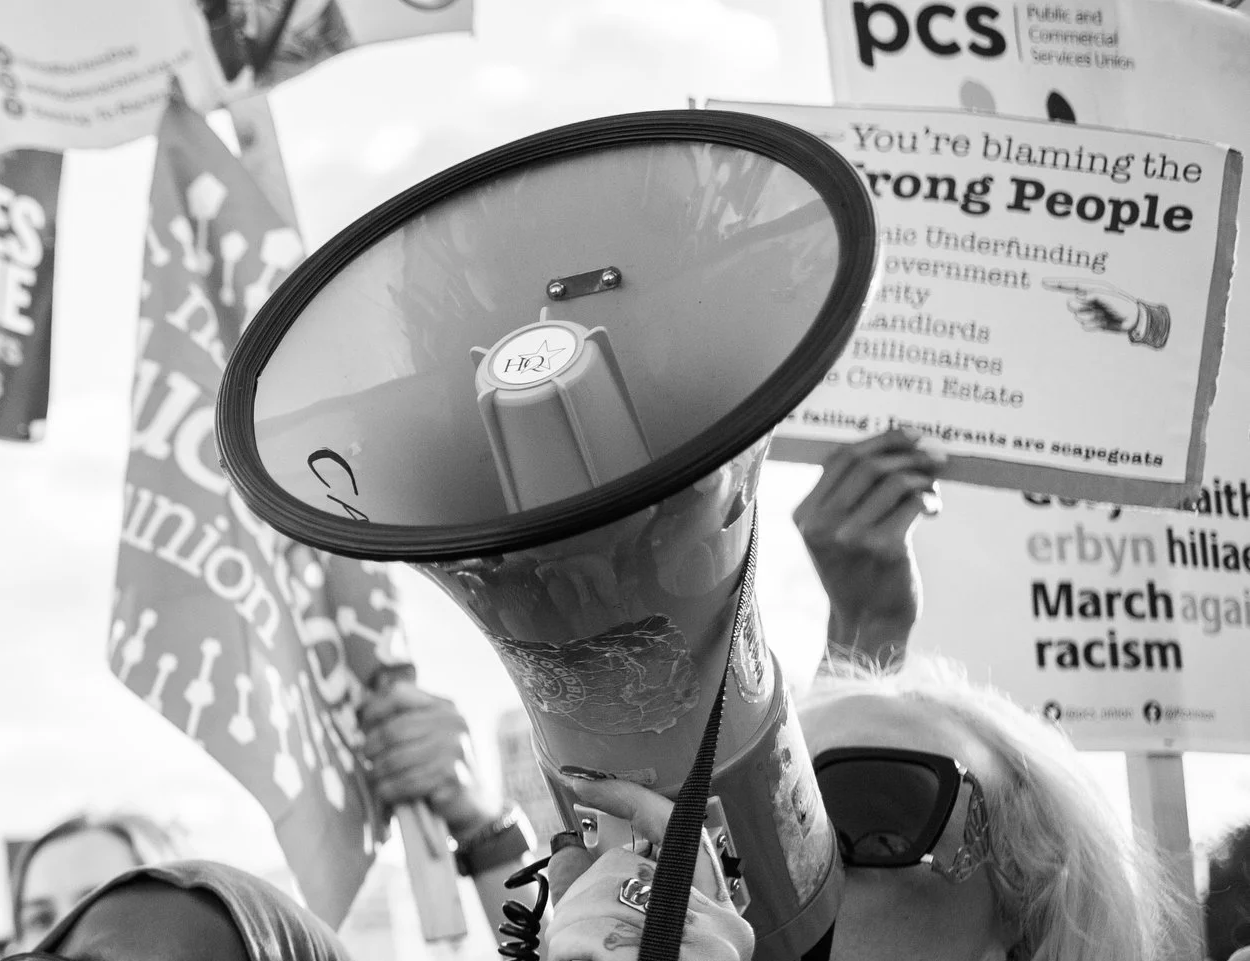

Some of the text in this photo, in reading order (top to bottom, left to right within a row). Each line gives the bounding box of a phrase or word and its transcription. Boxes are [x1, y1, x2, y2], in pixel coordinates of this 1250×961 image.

[851, 0, 1007, 68] pcs
[1027, 4, 1103, 25] Public and
[1028, 25, 1118, 47] Commercial
[1031, 47, 1135, 71] Services Union
[982, 132, 1135, 183] blaming
[1143, 153, 1202, 183] the
[856, 163, 1193, 234] rong People
[926, 226, 1109, 274] Underfunding
[885, 256, 1031, 289] overnment
[877, 282, 932, 309] rity
[846, 366, 933, 396] Crown
[942, 376, 1025, 408] Estate
[1013, 438, 1045, 452] are
[1051, 442, 1164, 467] scapegoats
[1027, 523, 1157, 578] erbyn
[1031, 579, 1175, 620] March
[1034, 629, 1183, 670] racism
